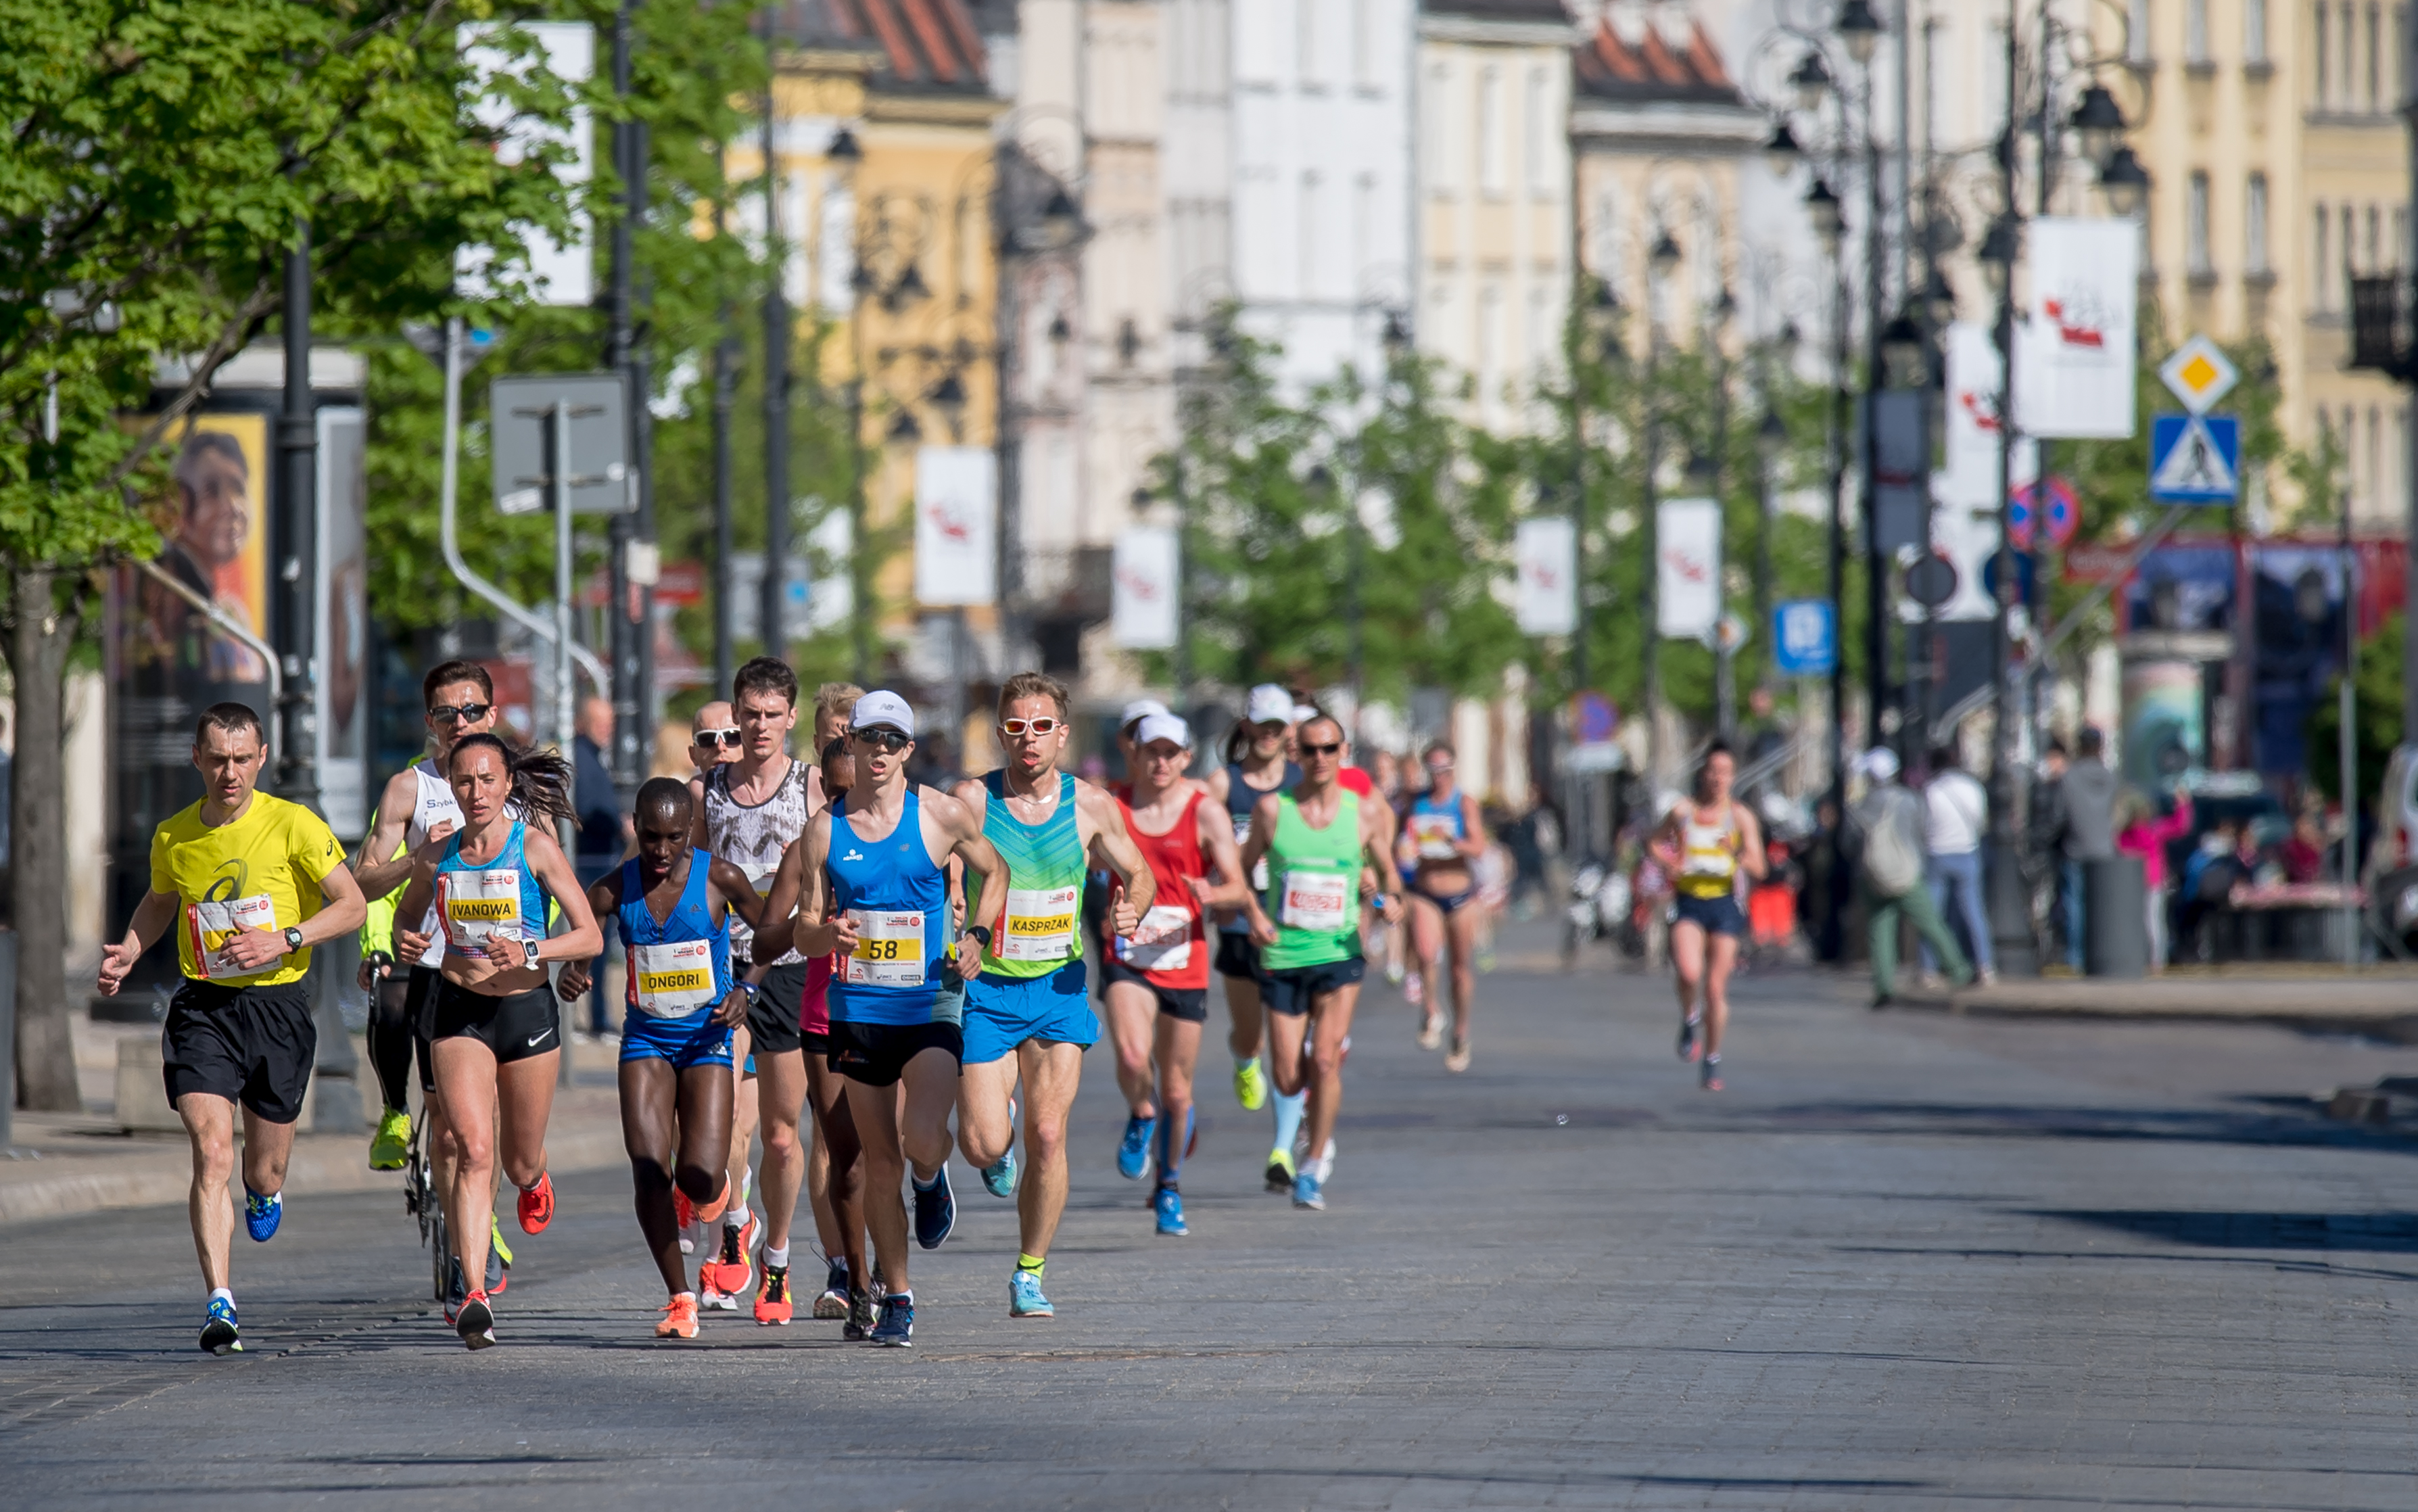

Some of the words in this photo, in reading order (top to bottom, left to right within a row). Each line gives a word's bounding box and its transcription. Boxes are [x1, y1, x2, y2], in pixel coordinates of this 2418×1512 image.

[452, 903, 511, 916] IVANOWA
[1012, 918, 1070, 932] KASPRZAK
[869, 940, 898, 960] 58
[648, 974, 699, 989] ONGORI
